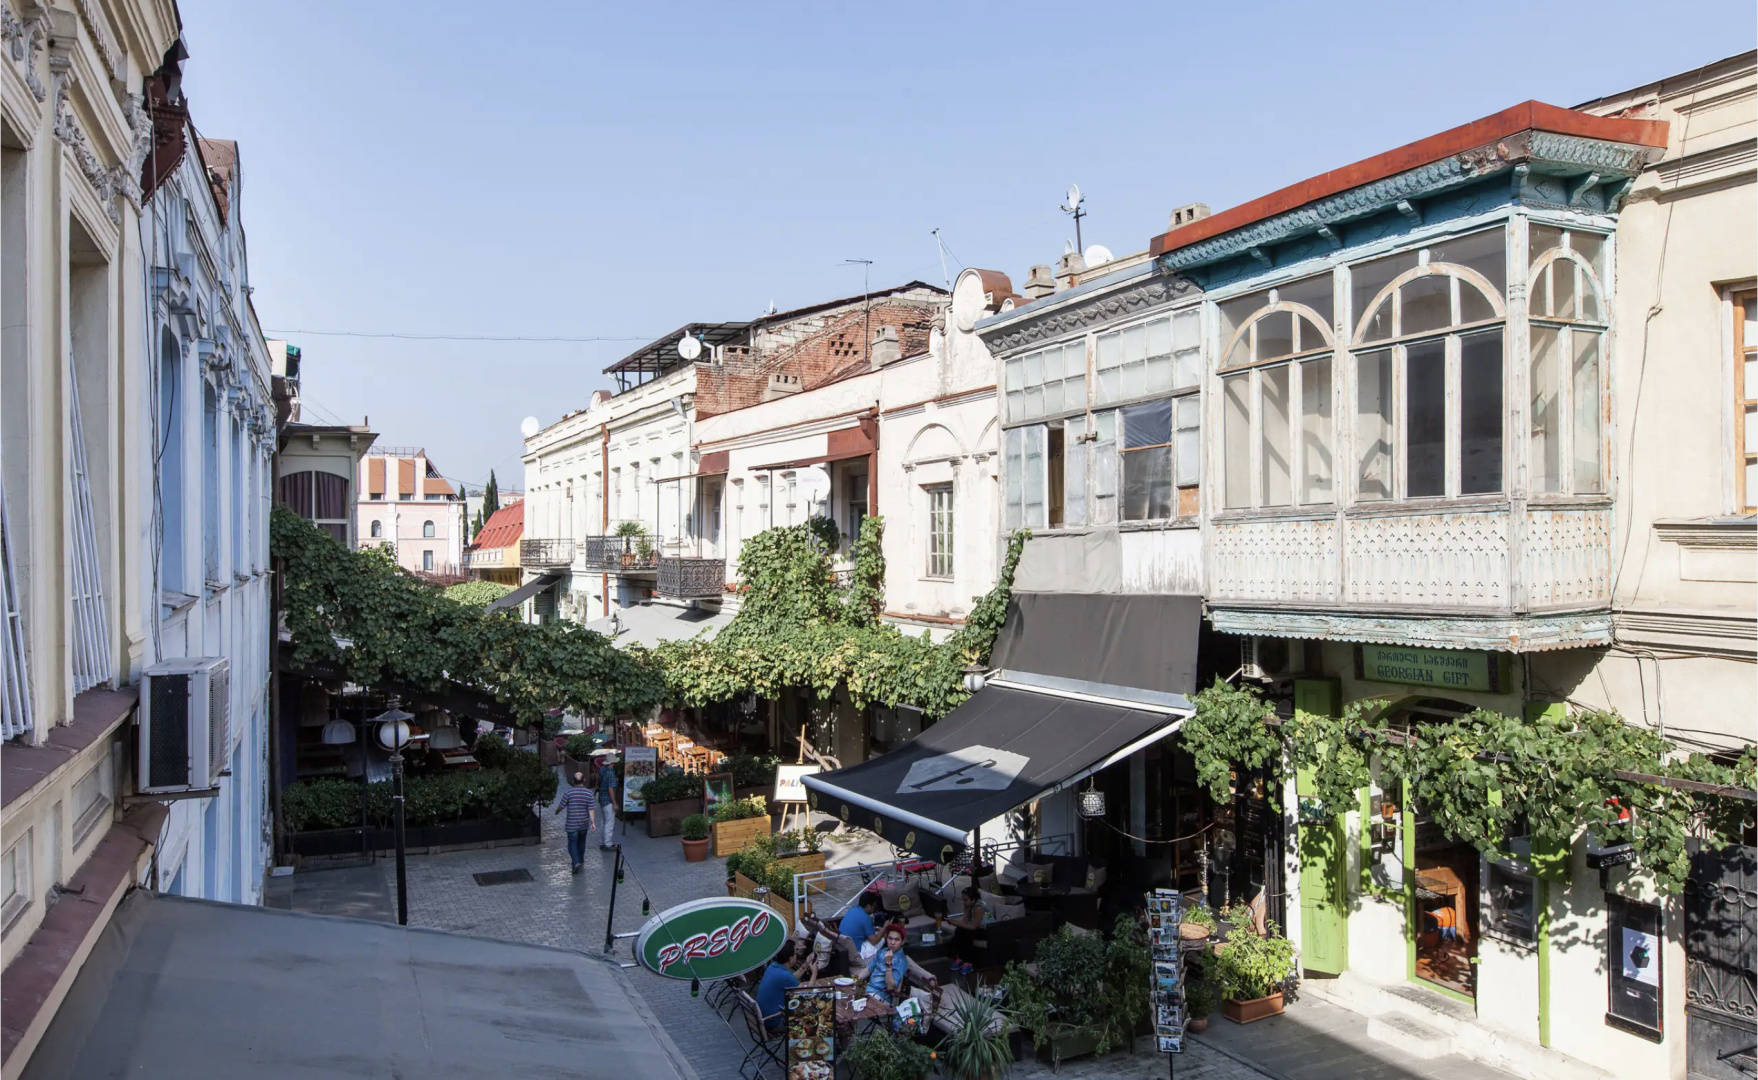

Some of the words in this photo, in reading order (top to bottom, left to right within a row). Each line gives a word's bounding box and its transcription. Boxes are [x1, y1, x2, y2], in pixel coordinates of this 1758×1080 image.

[1377, 664, 1433, 682] GEORGIAN
[1443, 671, 1470, 686] GIFT
[658, 909, 770, 975] PREGO
